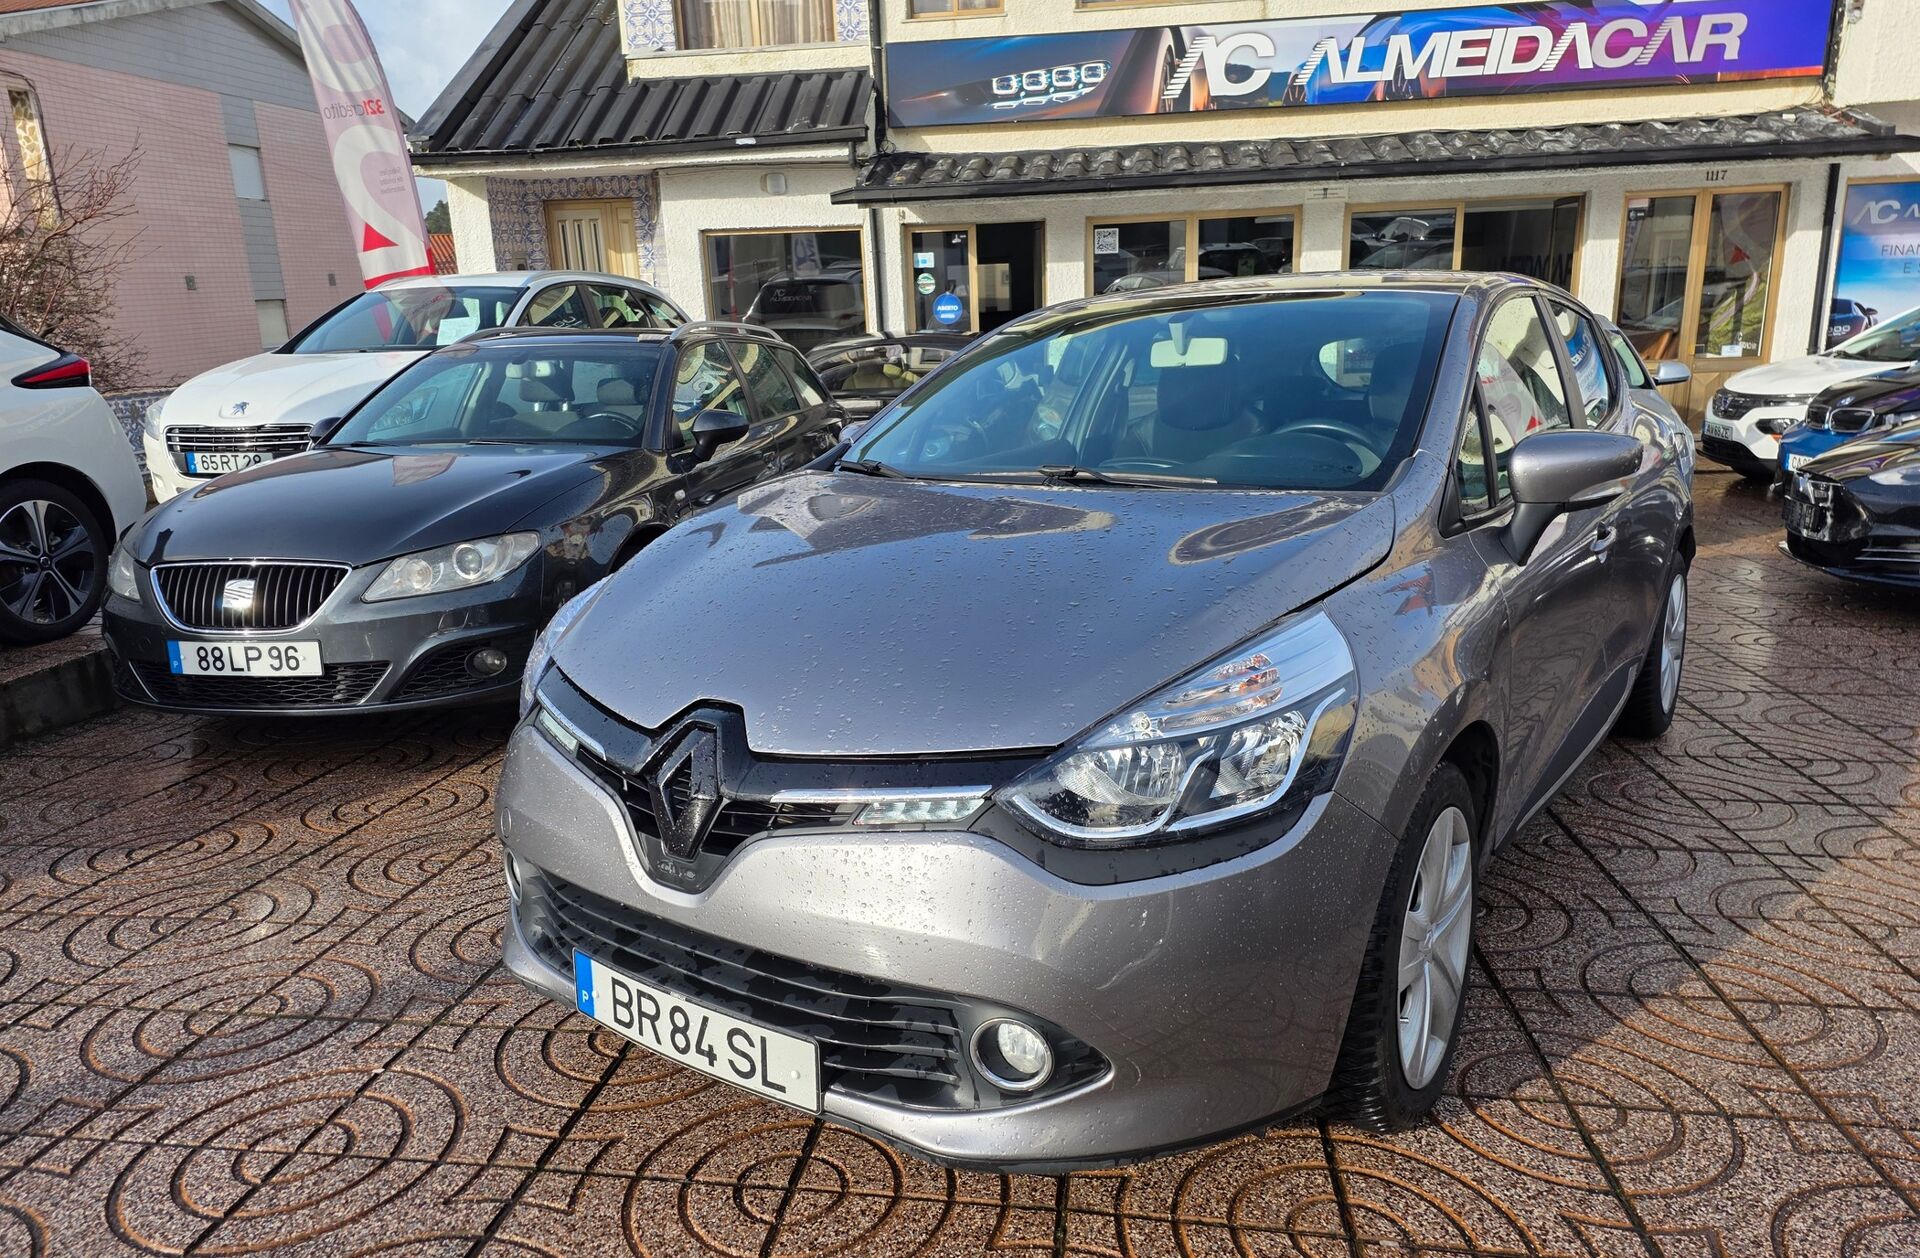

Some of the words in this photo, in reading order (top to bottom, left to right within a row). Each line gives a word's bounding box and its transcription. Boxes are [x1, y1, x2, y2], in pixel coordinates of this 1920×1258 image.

[1161, 32, 1275, 98] AC
[1293, 12, 1748, 86] ALMEIDACAR
[1706, 169, 1728, 181] 1117
[1852, 199, 1900, 225] AC
